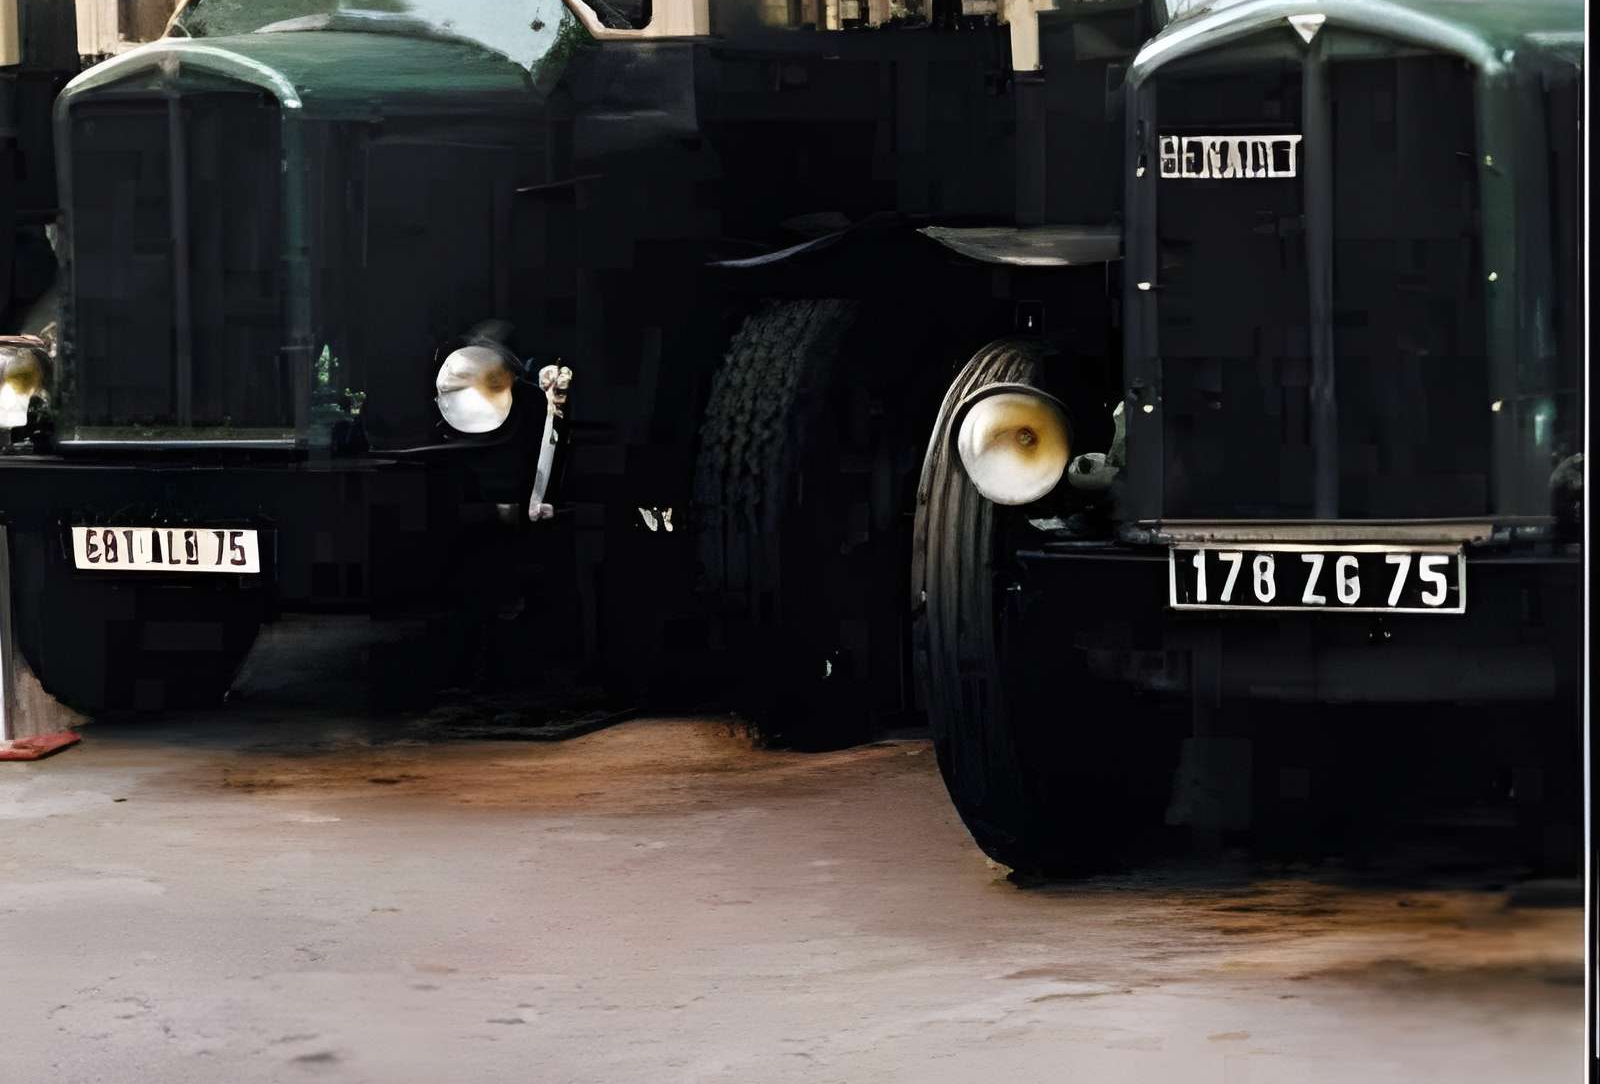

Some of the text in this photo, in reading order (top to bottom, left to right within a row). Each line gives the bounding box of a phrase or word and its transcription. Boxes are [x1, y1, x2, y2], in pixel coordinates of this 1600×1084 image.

[1193, 549, 1448, 607] 178 ZG 75
